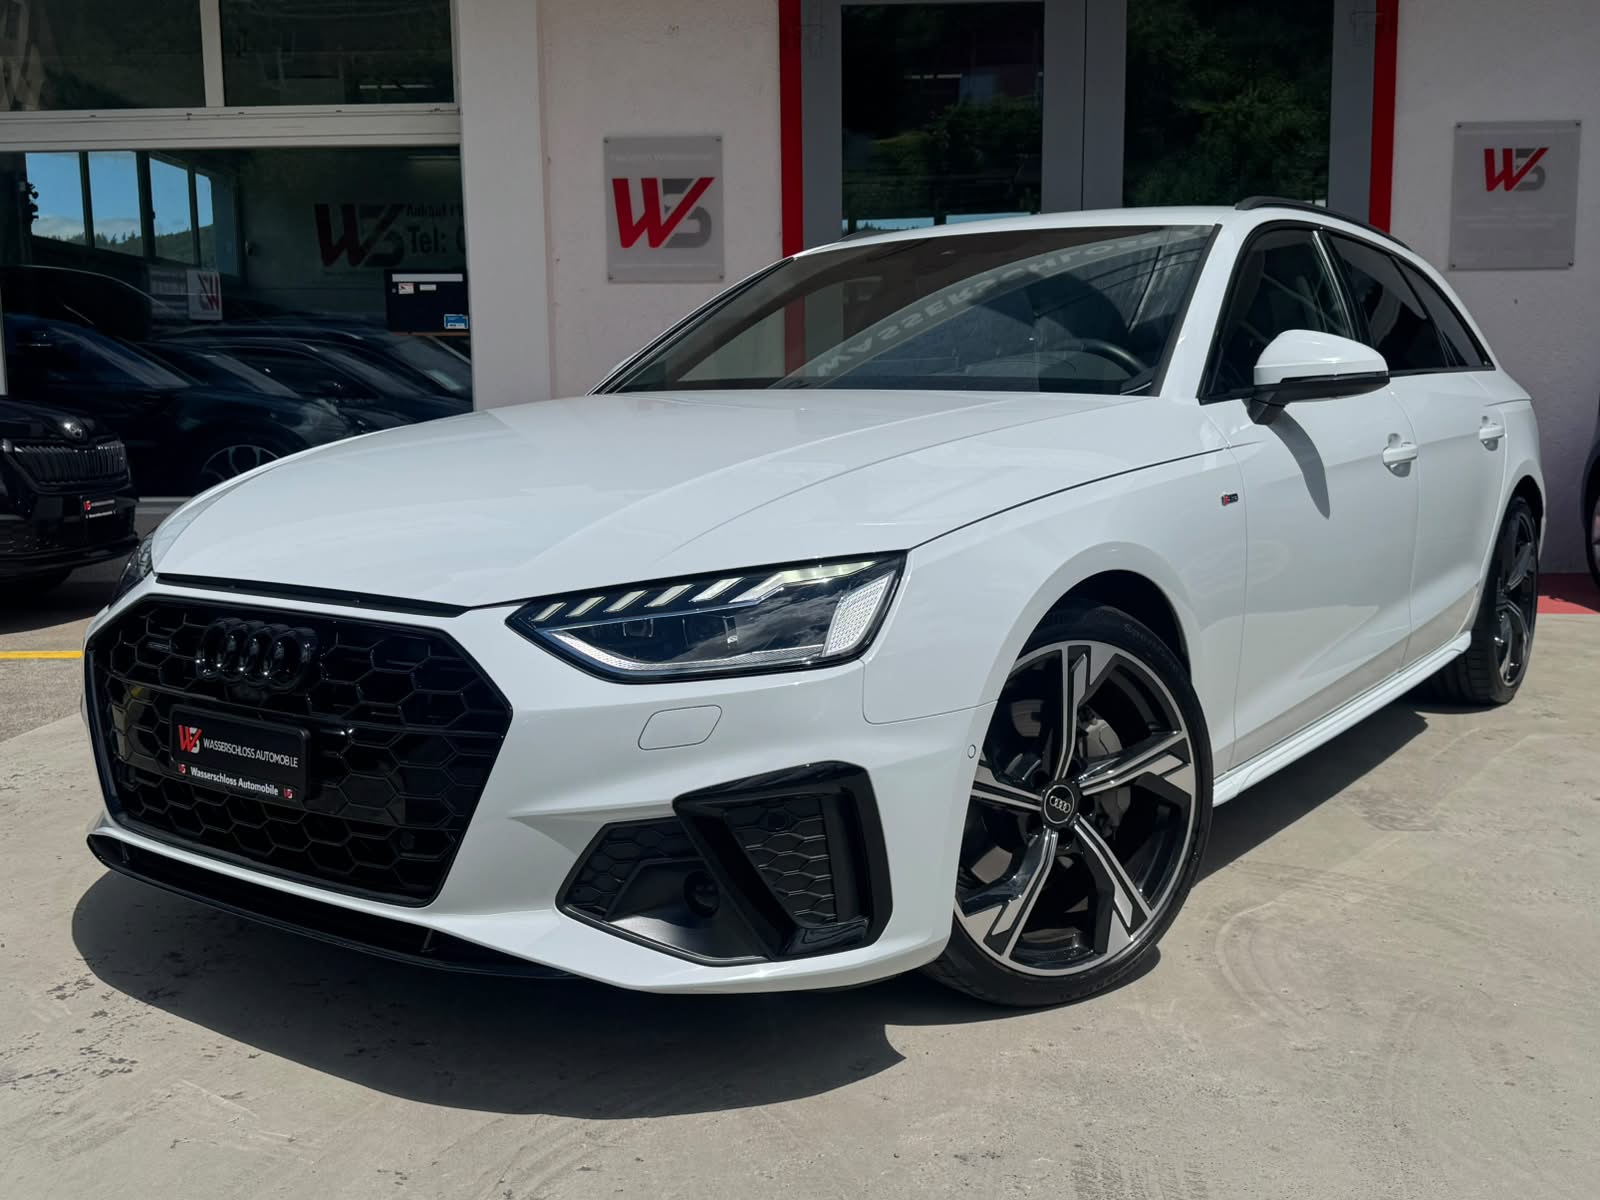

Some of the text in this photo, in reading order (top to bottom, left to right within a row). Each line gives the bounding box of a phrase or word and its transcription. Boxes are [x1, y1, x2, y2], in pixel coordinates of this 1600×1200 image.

[406, 225, 447, 254] Tel:
[203, 738, 255, 759] WASSERSCHLOSS
[256, 749, 299, 768] AUTOMOBLE
[190, 766, 237, 786] Wasserschloss
[238, 778, 279, 796] Automobile
